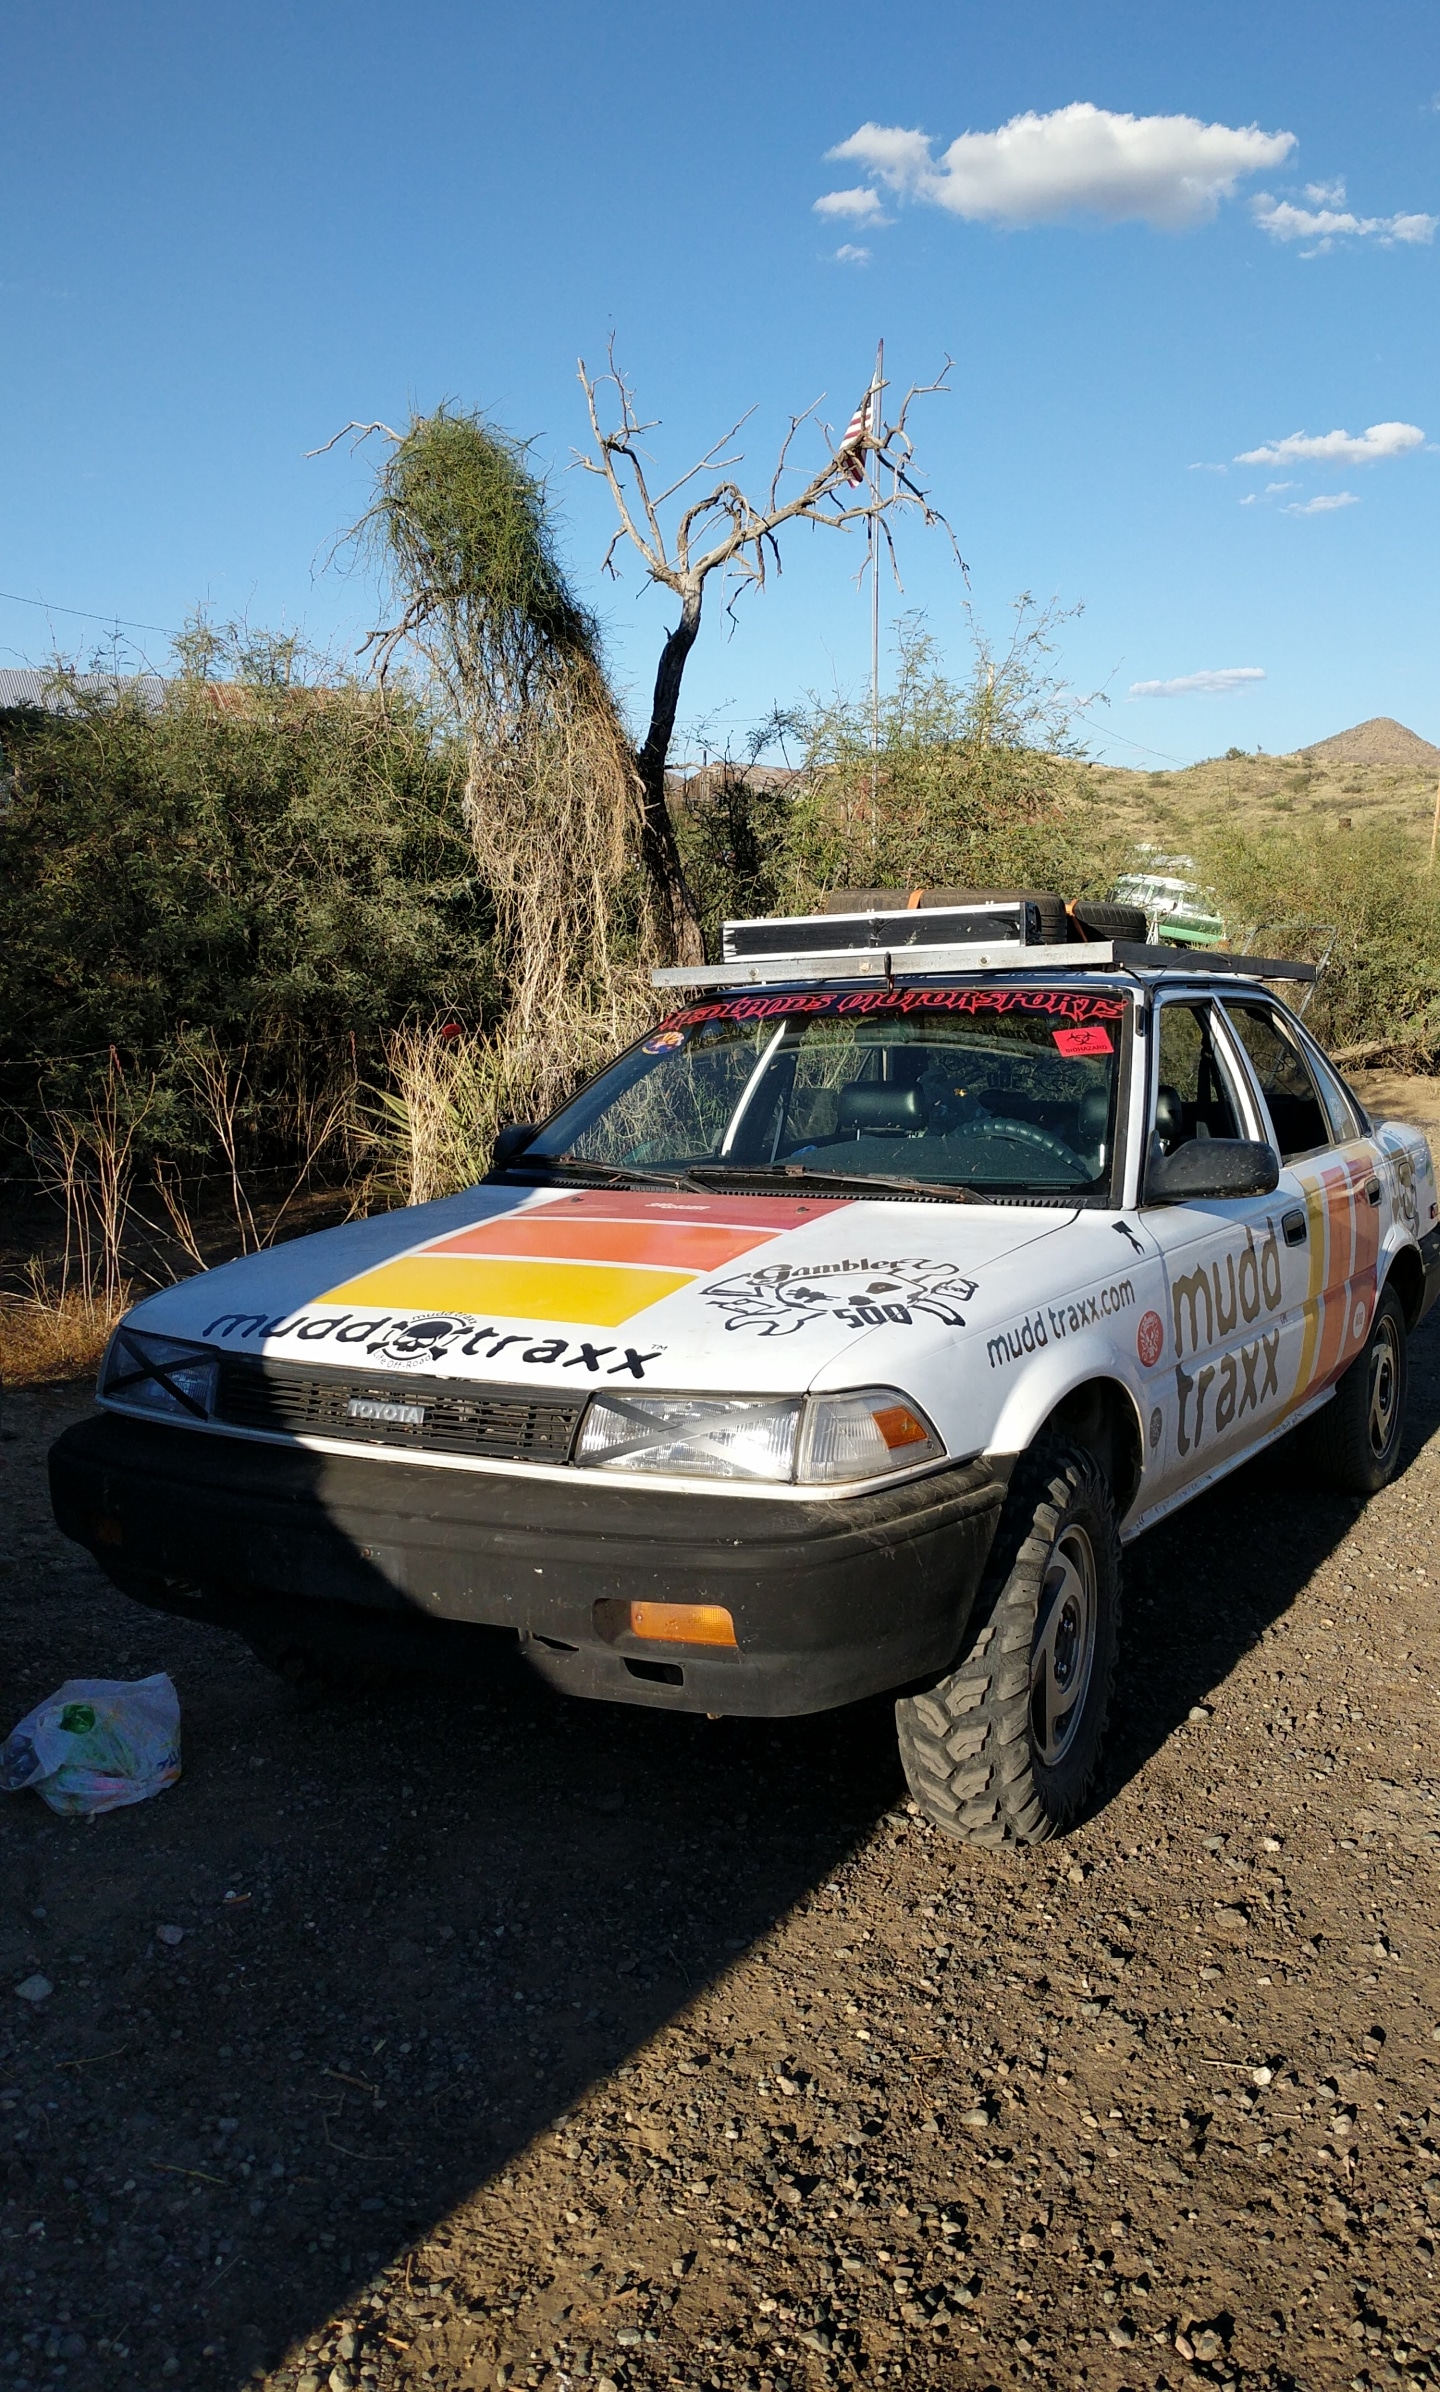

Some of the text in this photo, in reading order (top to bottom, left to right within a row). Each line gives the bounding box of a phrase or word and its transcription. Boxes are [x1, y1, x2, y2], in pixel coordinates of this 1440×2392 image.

[837, 989, 1127, 1022] MOTORSPORTS
[1065, 1045, 1108, 1053] BIOHAZARD
[746, 1258, 901, 1285] Gambler
[1172, 1216, 1282, 1359] mudd
[412, 1311, 478, 1325] mudd traxx
[832, 1303, 913, 1329] 500
[987, 1311, 1049, 1368] mudd
[1048, 1278, 1136, 1339] traxx.com
[202, 1314, 393, 1343] mudd
[462, 1327, 663, 1380] traxx
[373, 1350, 432, 1369] Life Off-Road
[1175, 1327, 1280, 1457] traxx
[350, 1400, 420, 1423] TOYOTA
